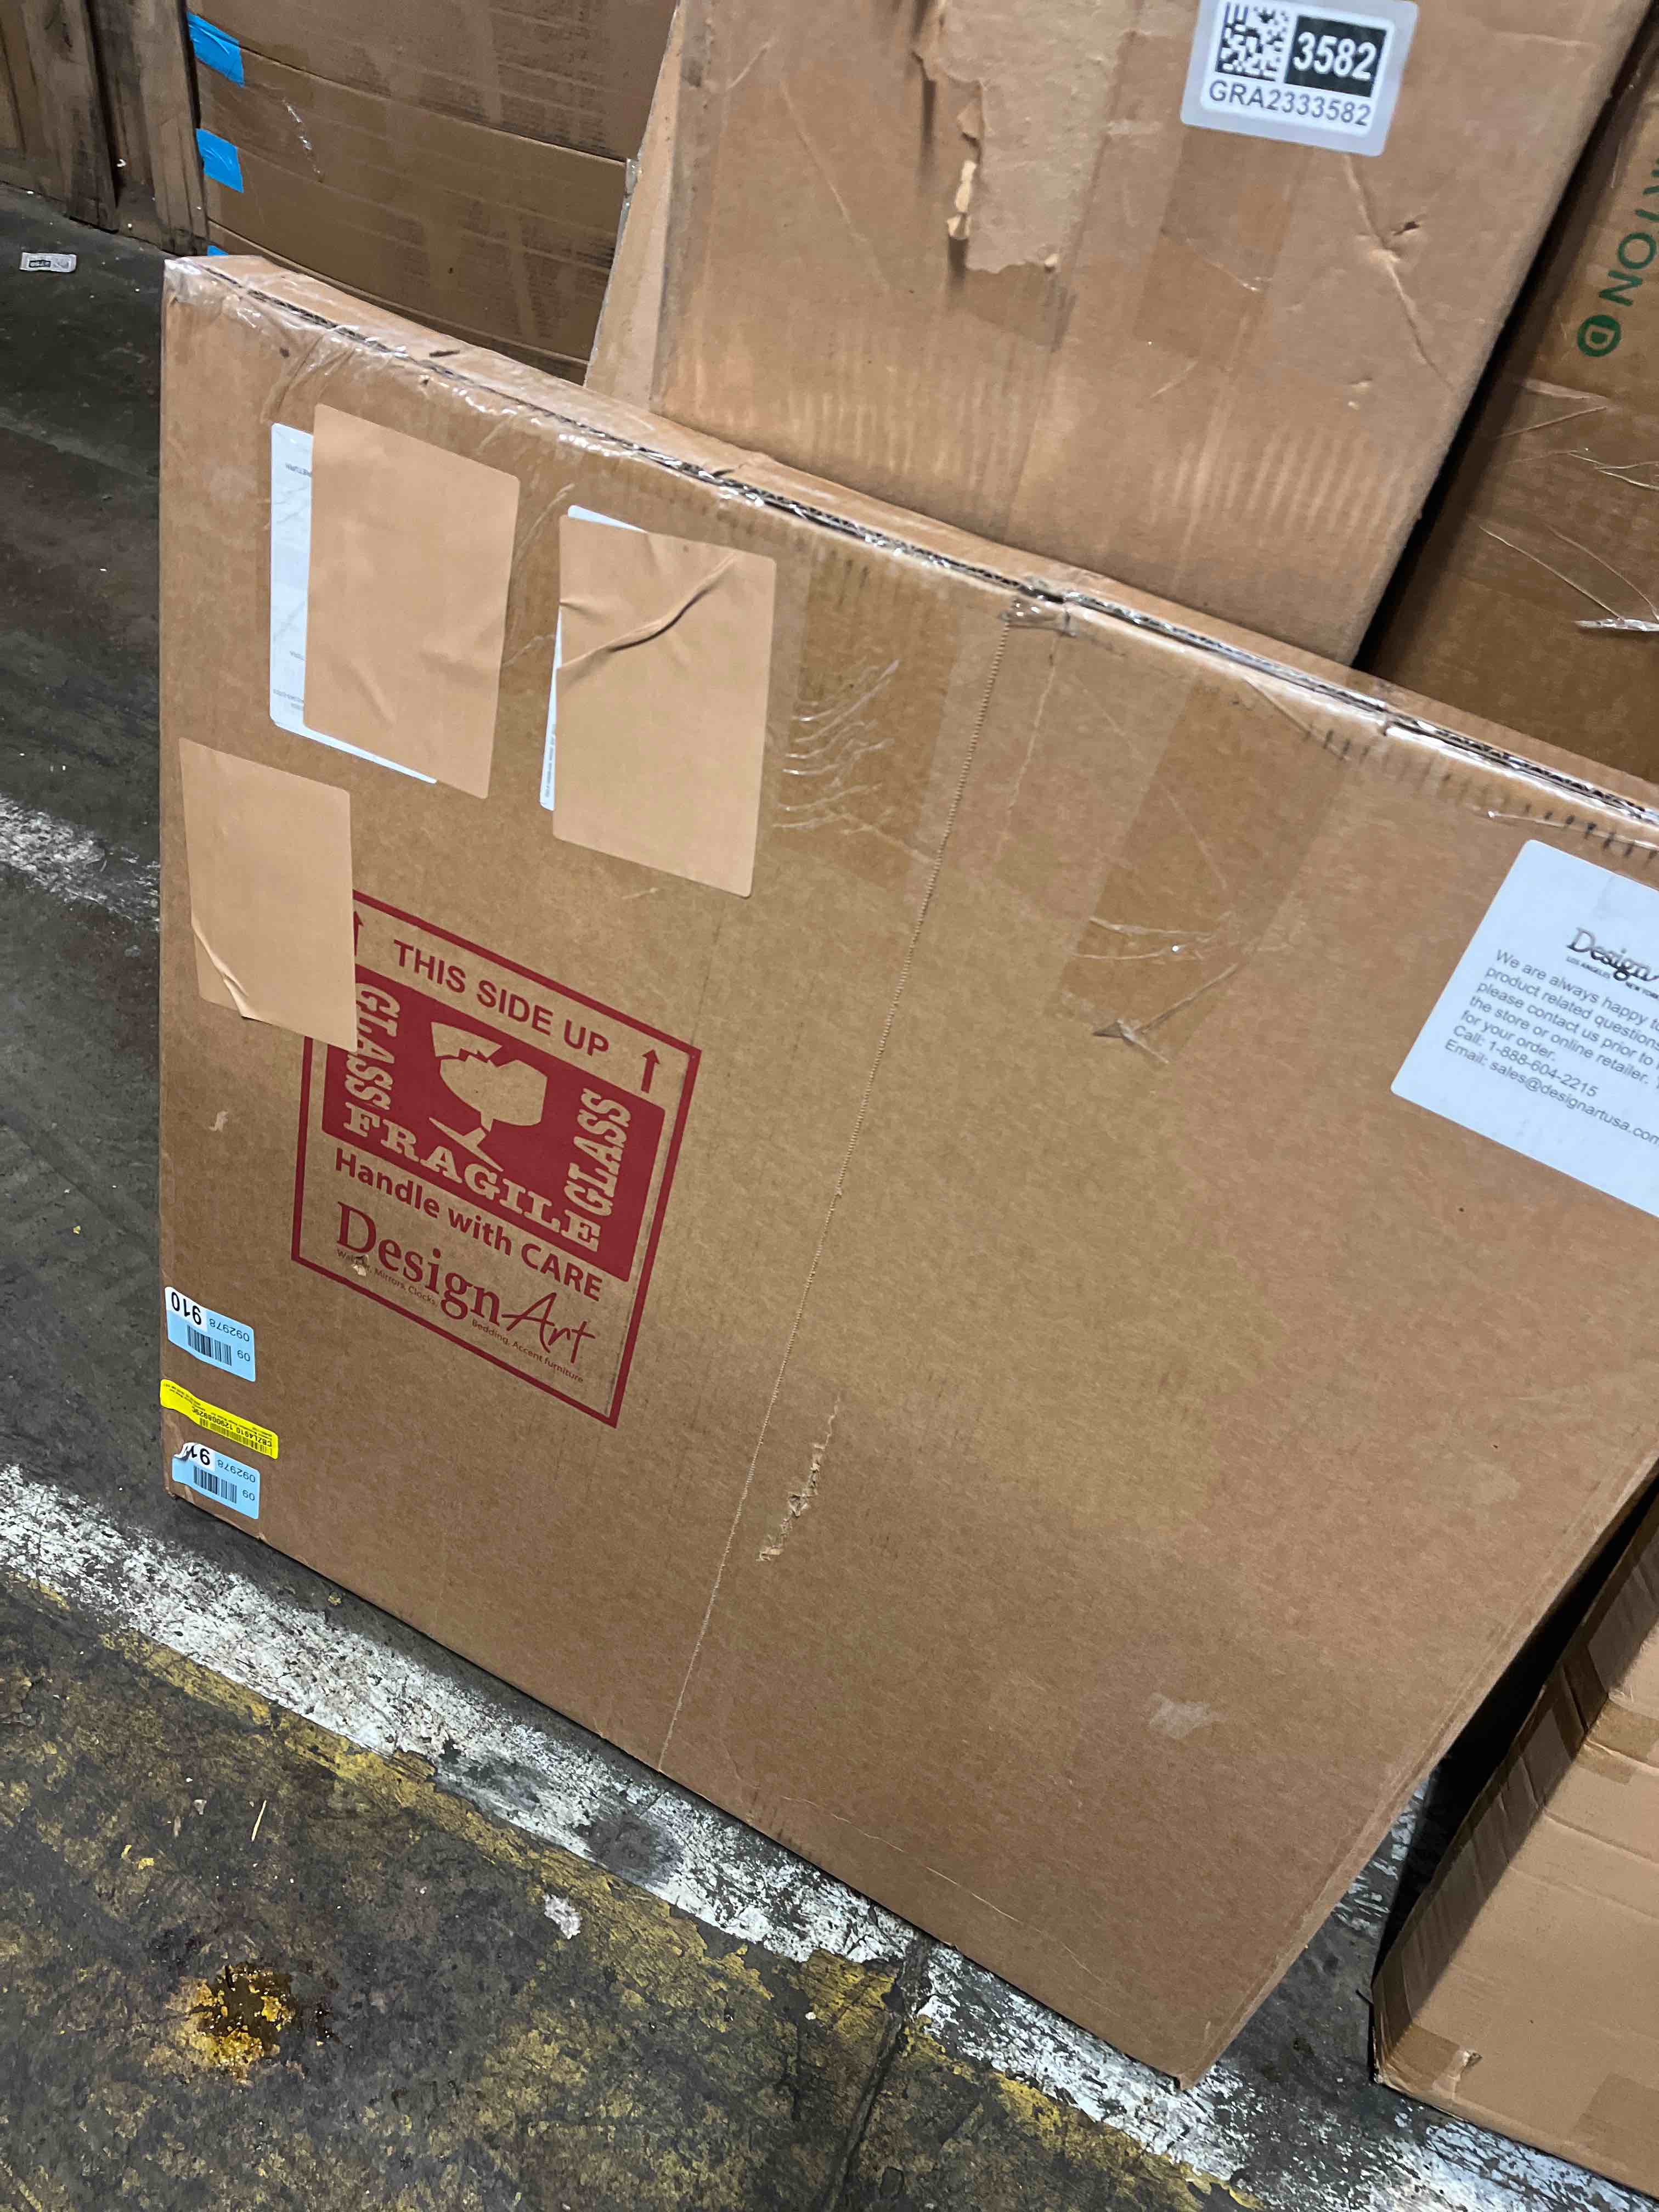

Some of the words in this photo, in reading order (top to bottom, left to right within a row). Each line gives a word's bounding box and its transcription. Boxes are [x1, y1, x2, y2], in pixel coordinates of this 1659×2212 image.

[1293, 31, 1376, 81] 3582
[1209, 79, 1371, 126] GRA2333582
[1566, 926, 1659, 981] Design
[393, 939, 467, 994] THIS
[476, 980, 554, 1036] SIDE
[563, 1019, 610, 1057] UP
[1485, 967, 1541, 997] product
[1541, 992, 1593, 1019] related
[1497, 949, 1520, 968] We
[1522, 964, 1547, 980] are
[1549, 975, 1599, 1003] always
[1602, 996, 1648, 1025] happy
[345, 983, 400, 1110] GLASS
[1462, 1009, 1481, 1025] for
[1481, 1022, 1516, 1040] your
[1516, 1037, 1555, 1062] order.
[1470, 995, 1492, 1013] the
[1495, 1008, 1530, 1030] store
[1533, 1026, 1549, 1037] or
[1550, 1034, 1594, 1058] online
[1595, 1054, 1649, 1084] retailer.
[1477, 983, 1524, 1008] please
[1527, 1004, 1579, 1034] contact
[1582, 1028, 1599, 1042] us
[1600, 1037, 1638, 1058] prior
[1639, 1052, 1654, 1066] to
[1445, 1039, 1488, 1066] Email:
[1489, 1062, 1659, 1146] sales@designartusa.com
[1453, 1025, 1485, 1047] Call:
[1489, 1041, 1598, 1097] 1-888-604-2215
[342, 1102, 601, 1252] FRAGILE
[563, 1088, 631, 1216] GLASS
[335, 1147, 439, 1220] Handle
[448, 1207, 512, 1256] with
[521, 1243, 603, 1302] CARE
[171, 1291, 202, 1325] 910
[209, 1318, 250, 1342] 092978
[237, 1350, 251, 1362] 09
[472, 1318, 511, 1346] Bedding,
[513, 1341, 543, 1362] Accent
[545, 1357, 584, 1383] furniture
[217, 1459, 256, 1483] 092978
[242, 1489, 255, 1501] 09
